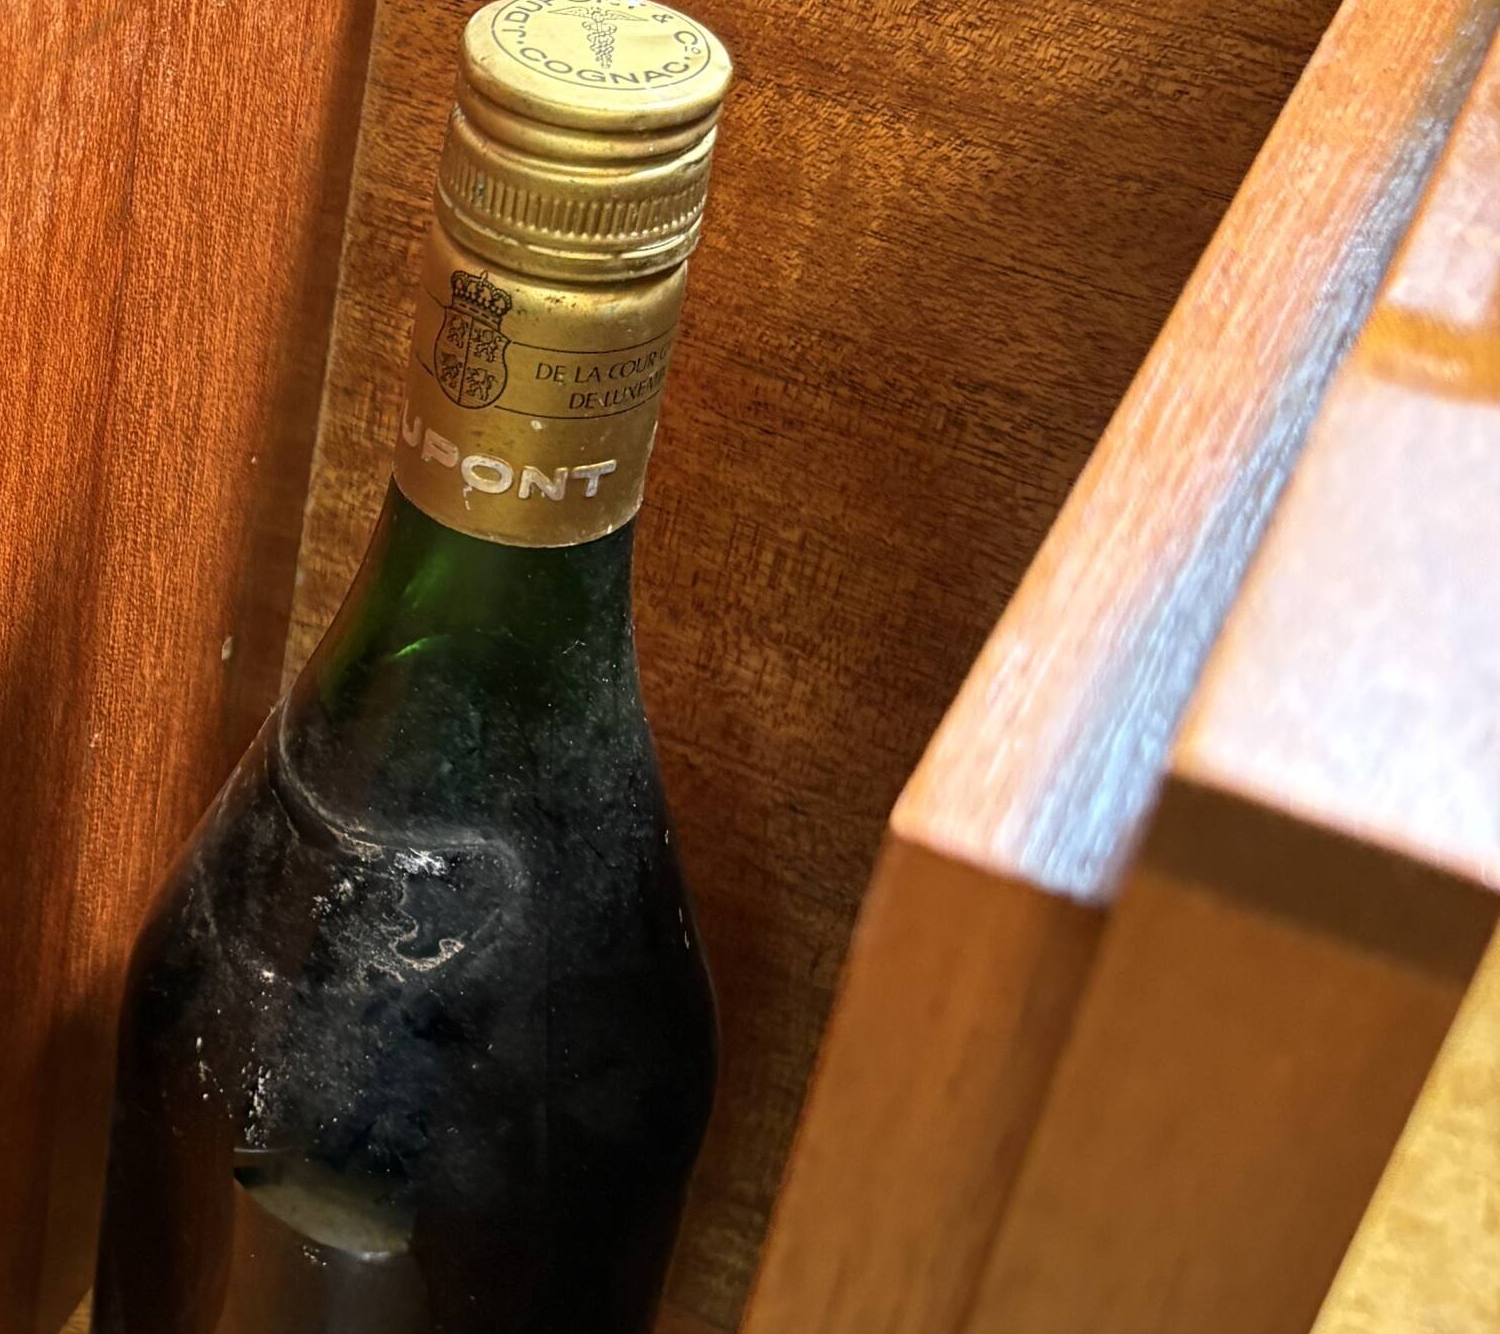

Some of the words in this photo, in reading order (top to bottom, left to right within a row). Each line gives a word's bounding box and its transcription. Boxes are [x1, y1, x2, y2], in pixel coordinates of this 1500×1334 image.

[652, 13, 673, 23] &
[520, 47, 689, 84] COGNAC
[536, 362, 566, 383] DE
[575, 366, 601, 384] LA
[608, 351, 657, 380] COUR
[569, 392, 597, 410] DE
